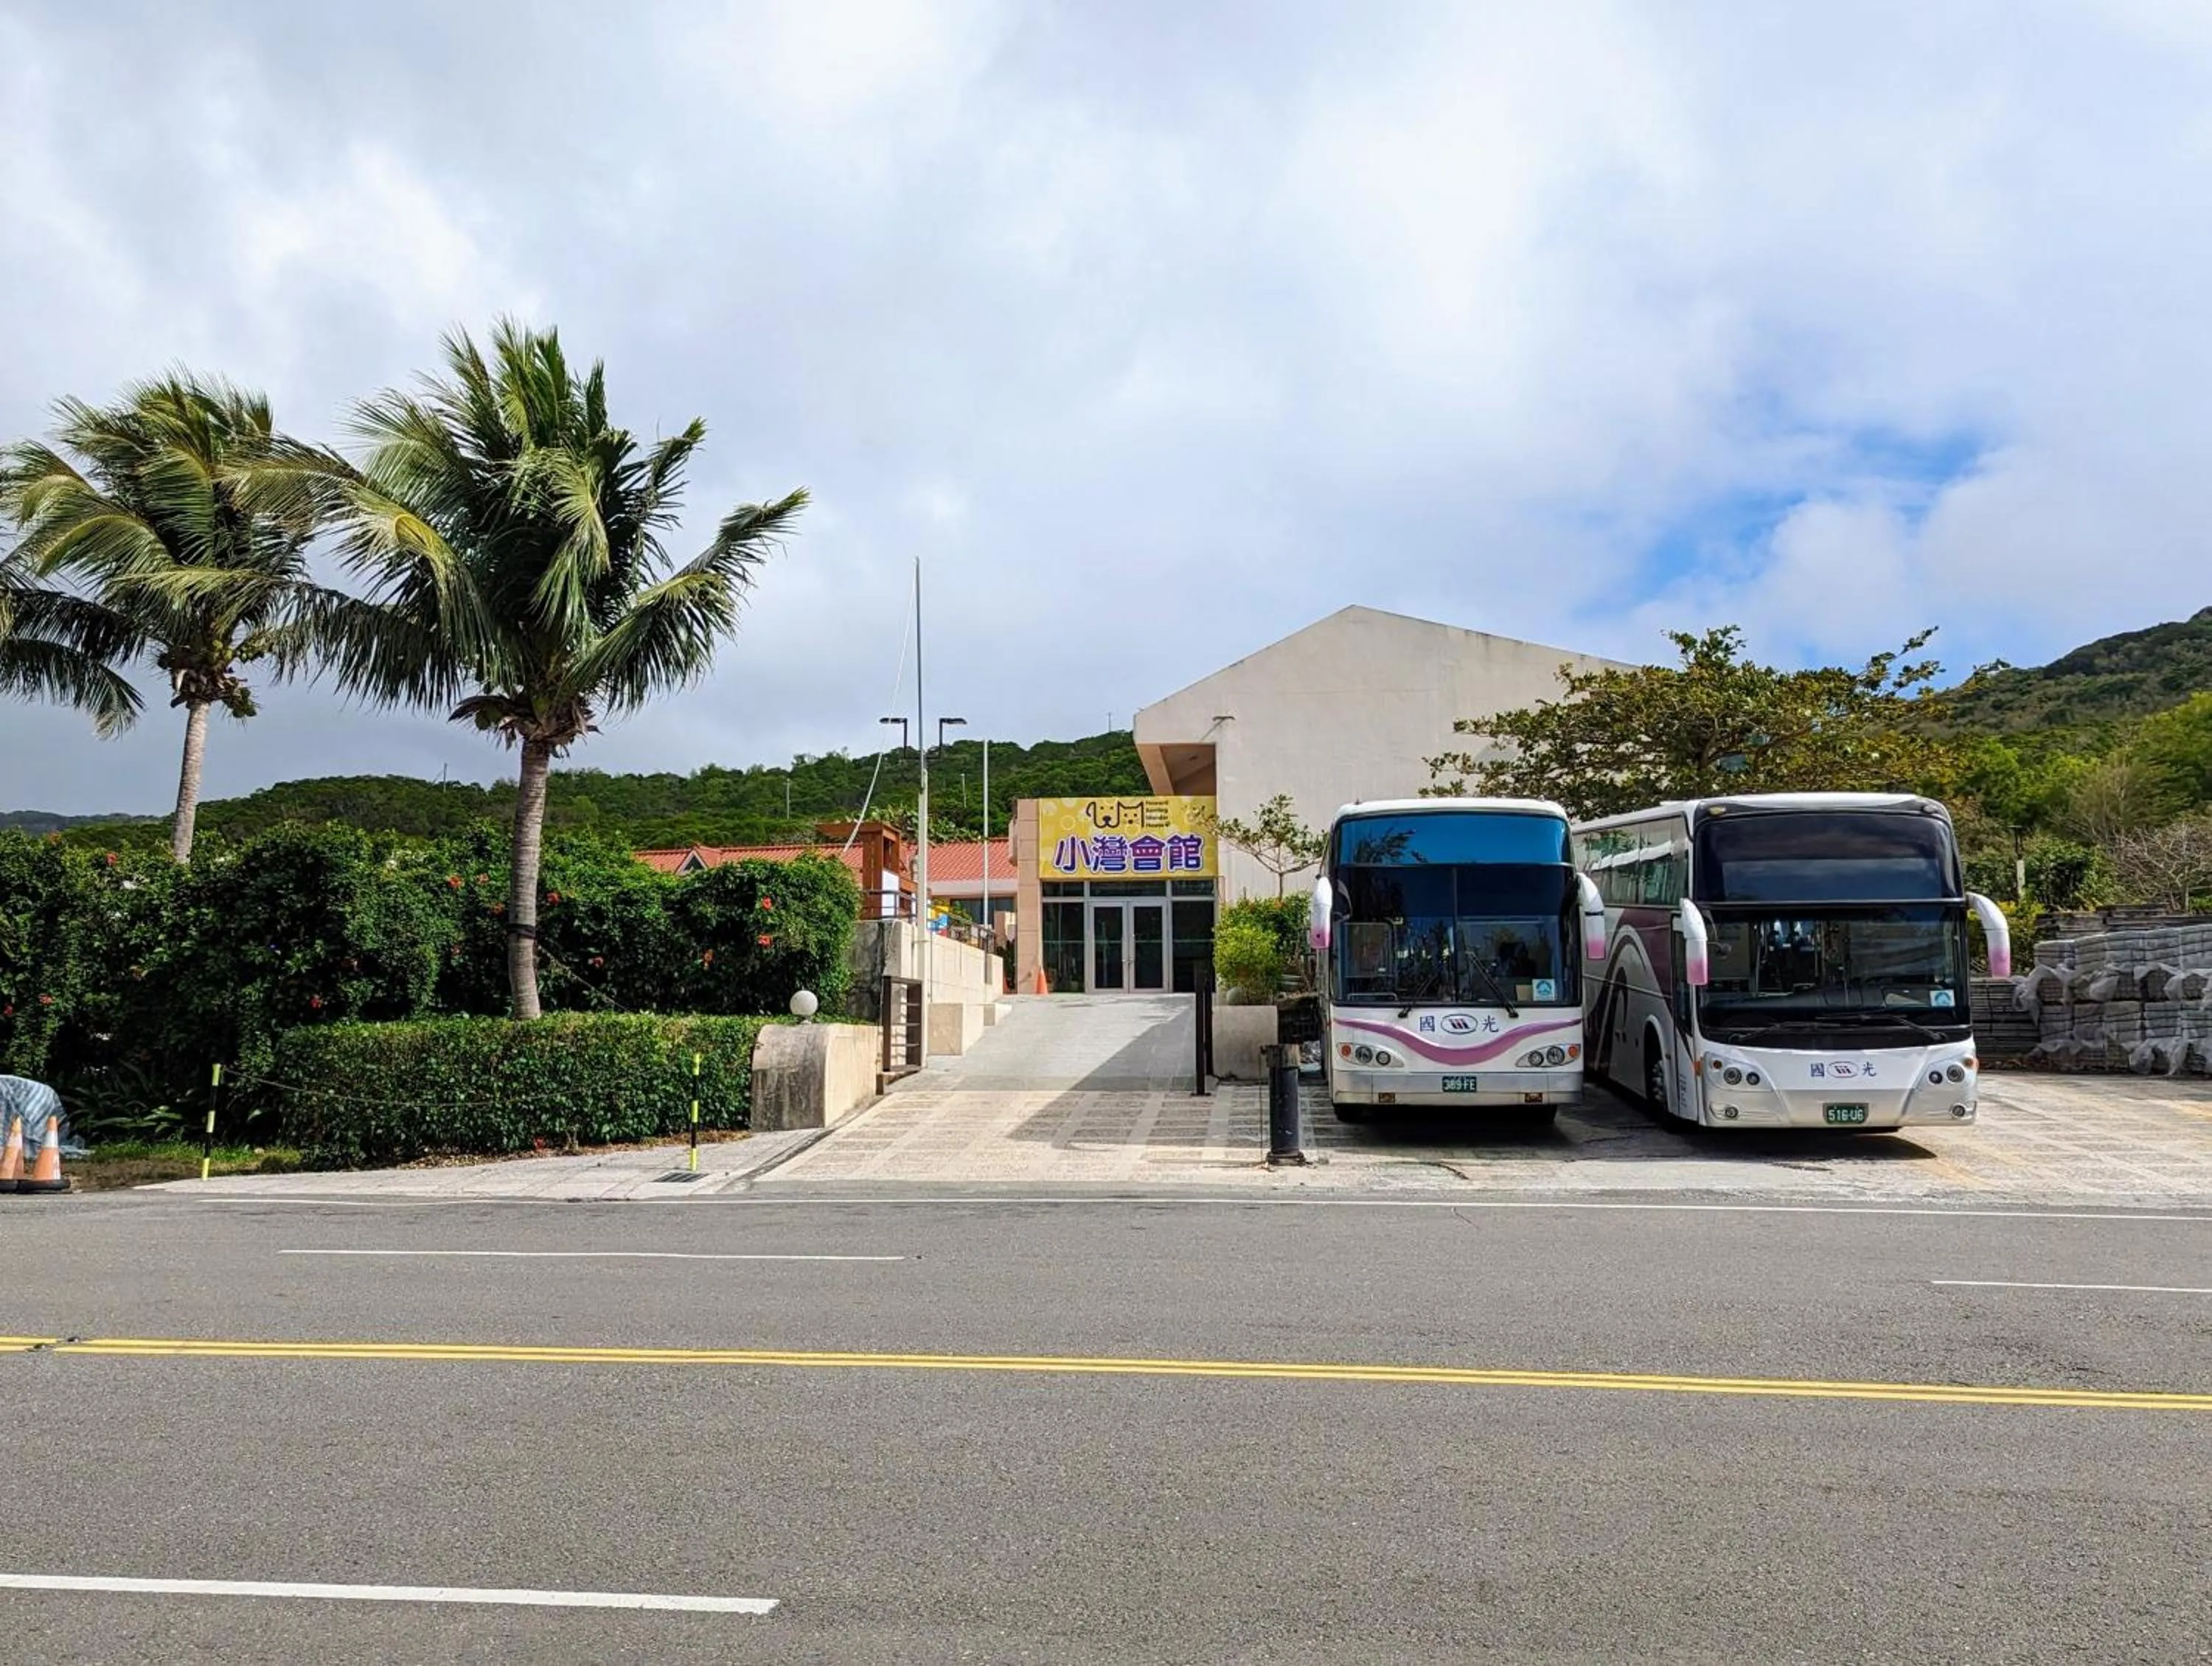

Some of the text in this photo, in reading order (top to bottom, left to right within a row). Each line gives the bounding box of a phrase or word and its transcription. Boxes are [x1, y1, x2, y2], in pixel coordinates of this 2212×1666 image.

[1054, 834, 1203, 872] 小灣會館
[1482, 1014, 1499, 1033] 光
[1863, 1061, 1877, 1077] 光
